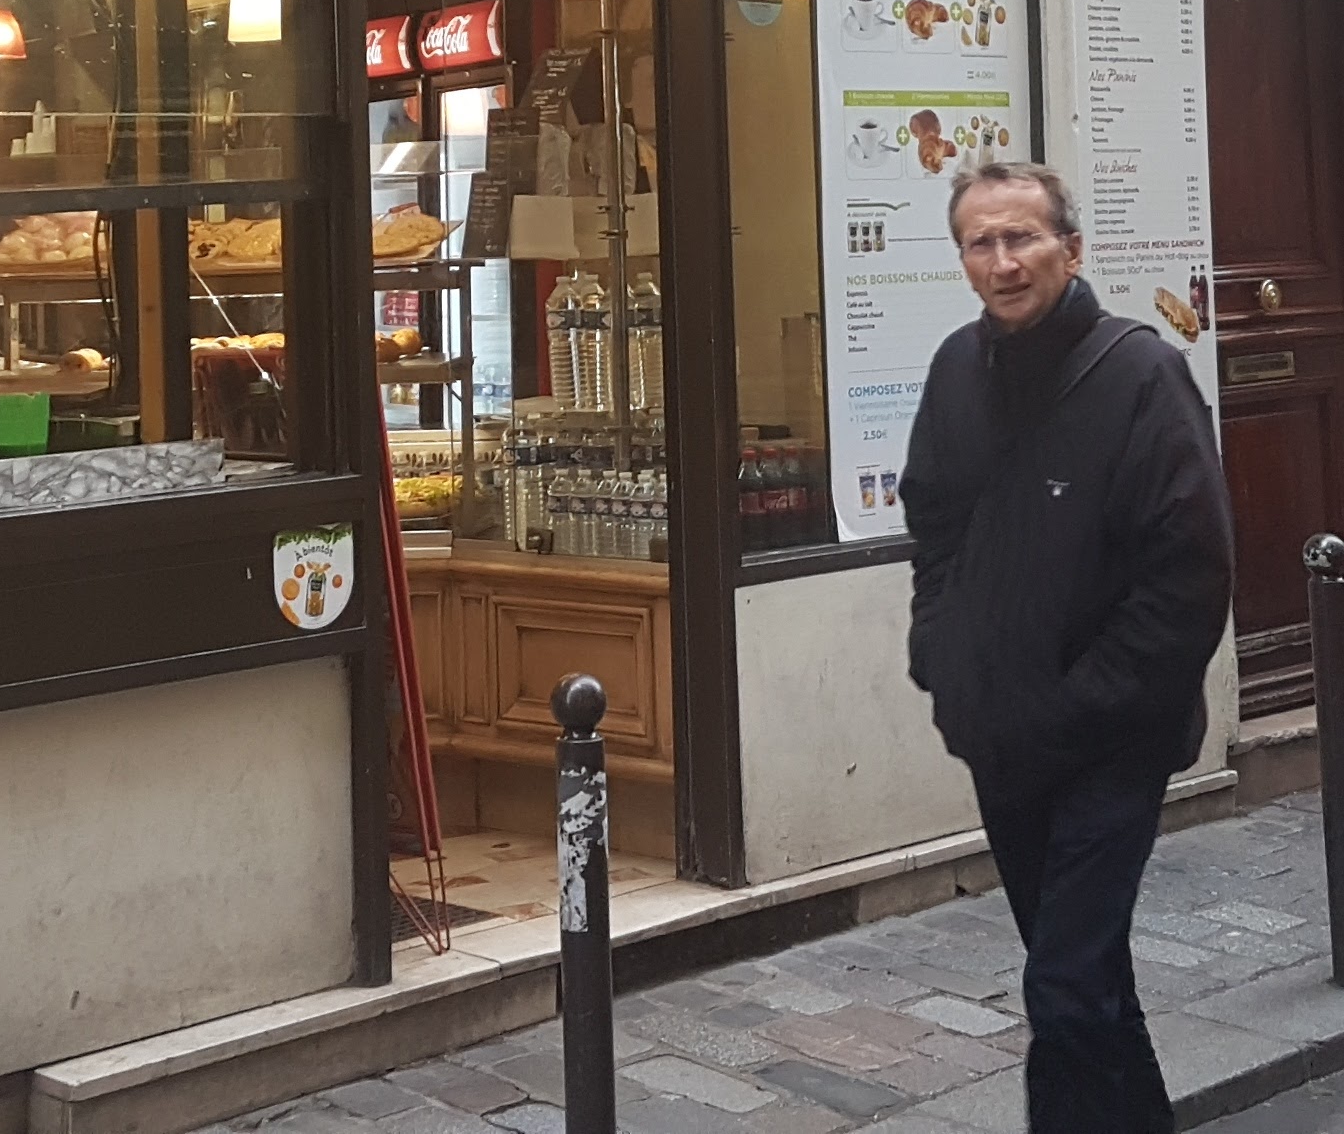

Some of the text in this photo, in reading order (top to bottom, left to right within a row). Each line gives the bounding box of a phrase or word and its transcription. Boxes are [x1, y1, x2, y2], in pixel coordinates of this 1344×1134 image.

[846, 269, 964, 286] NOS BOISSONS CHAUDES
[847, 381, 924, 398] COMPOSEZ VOT
